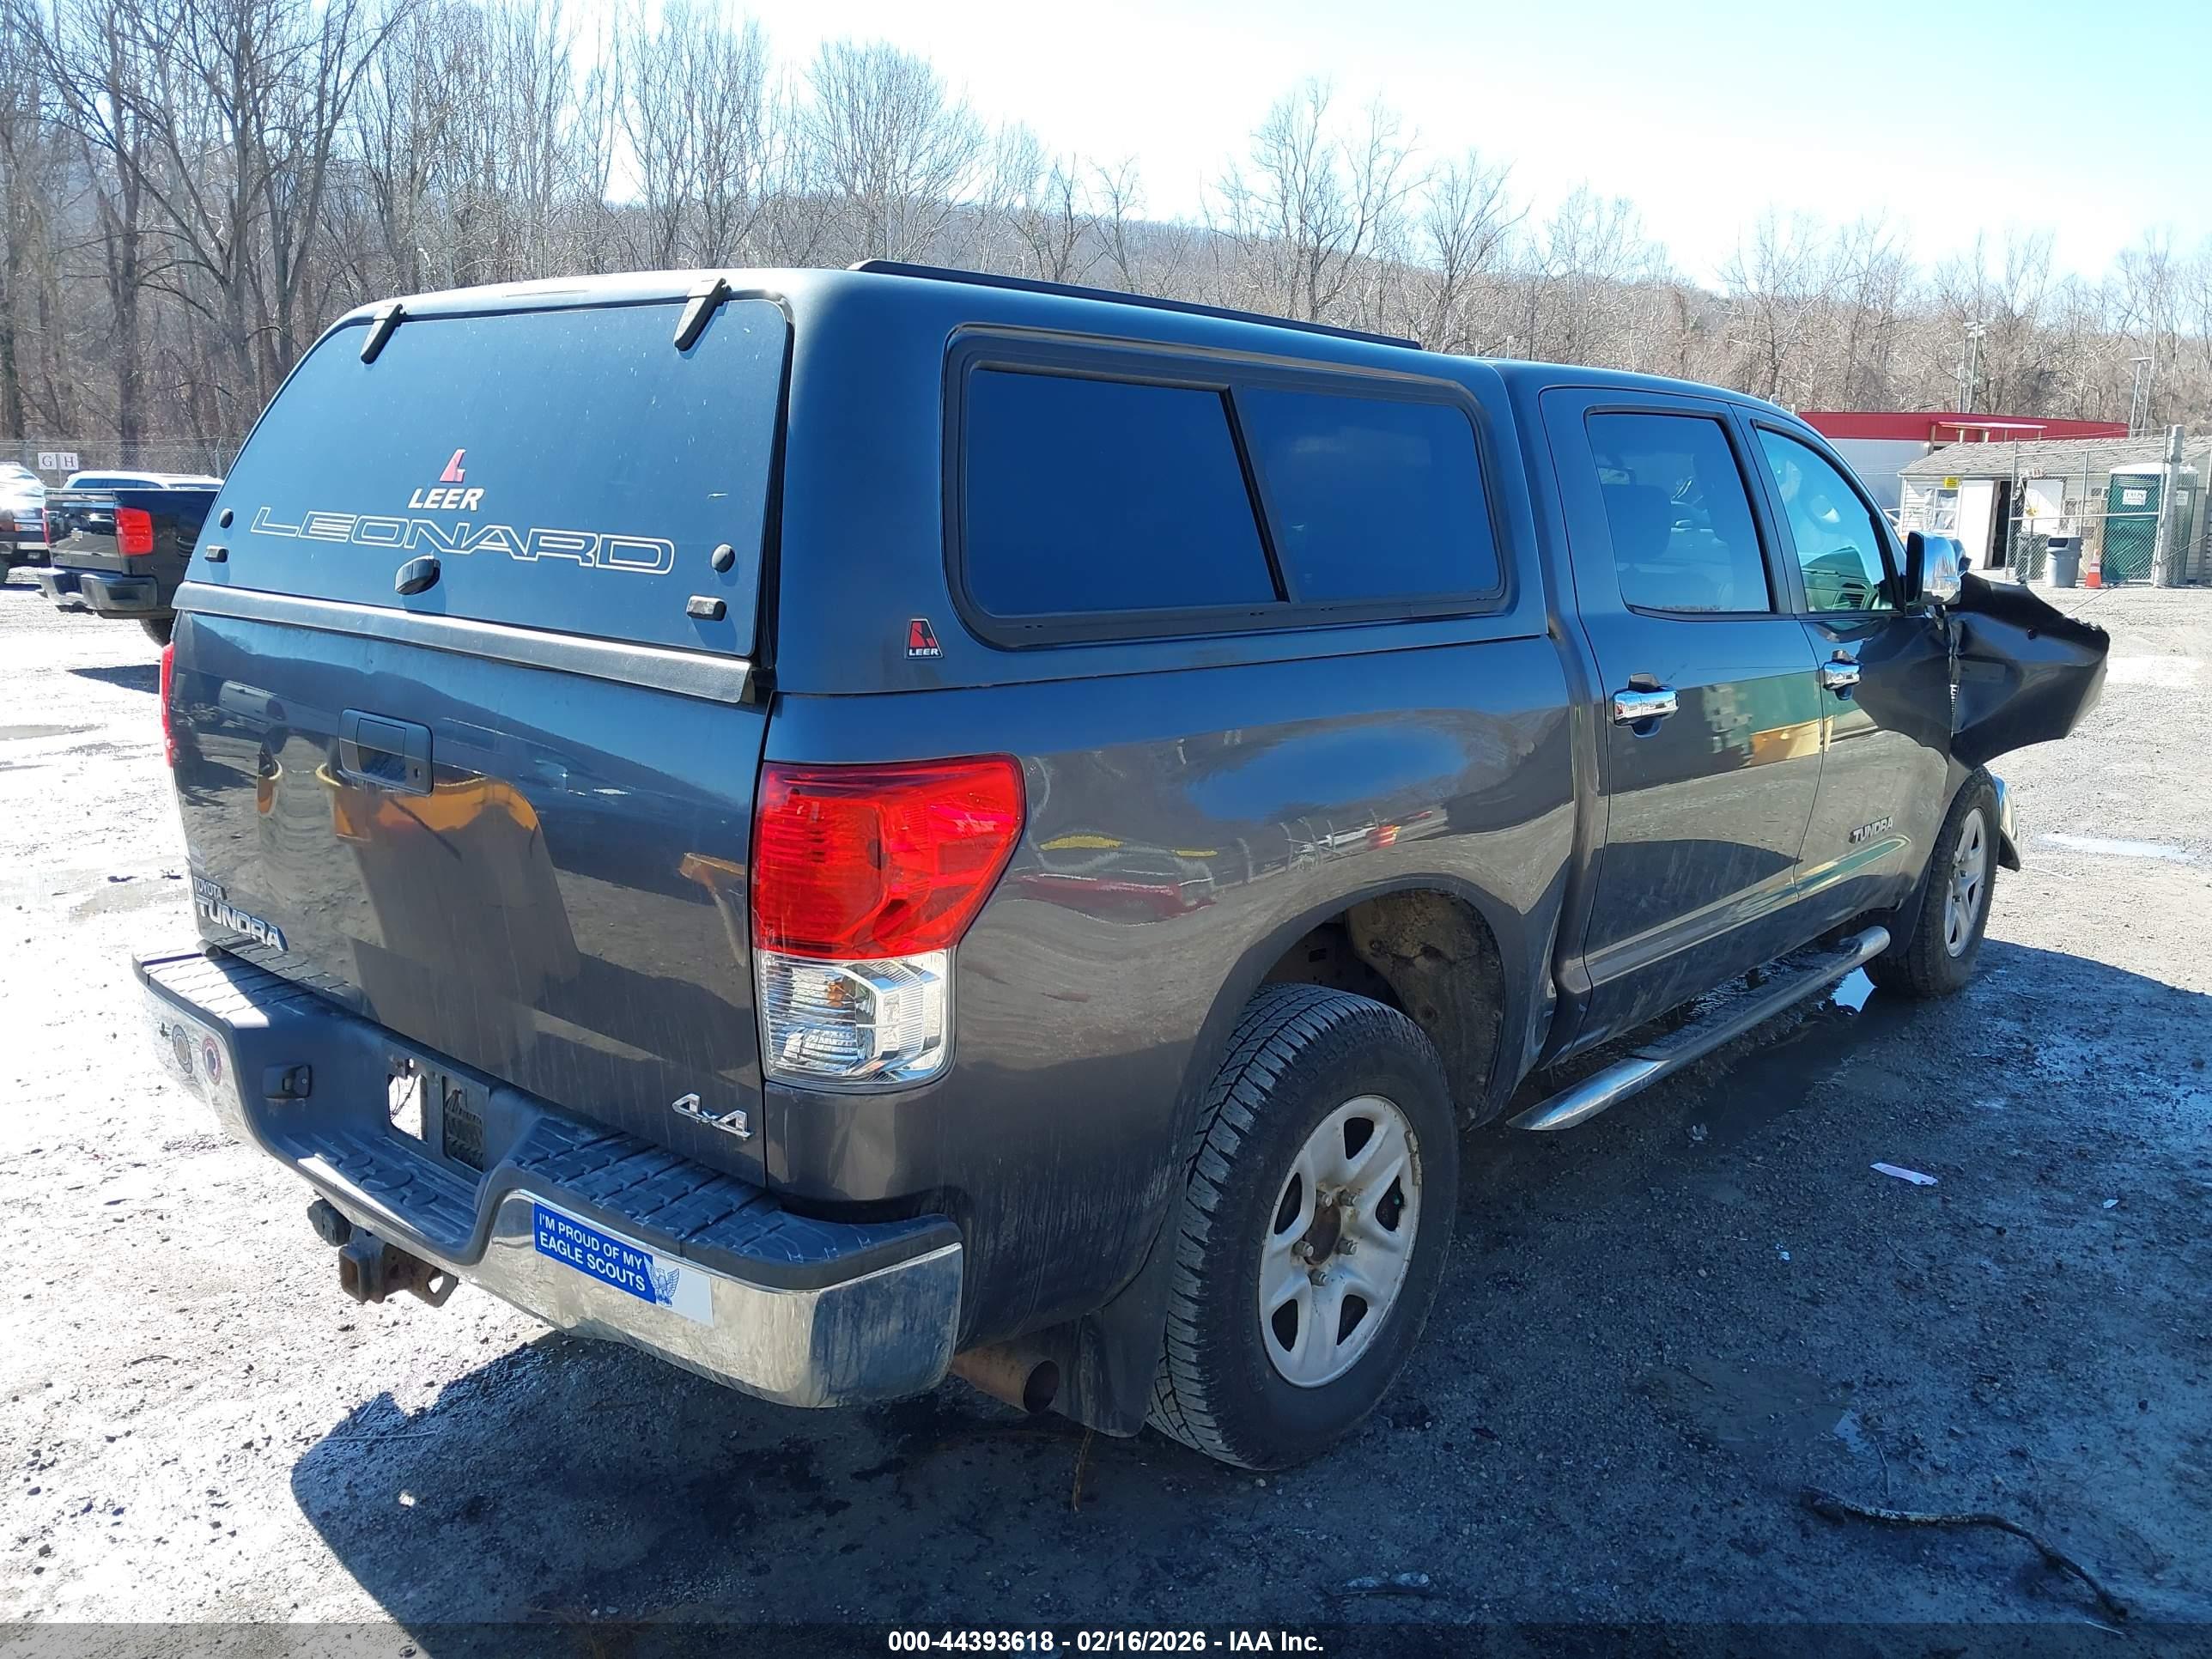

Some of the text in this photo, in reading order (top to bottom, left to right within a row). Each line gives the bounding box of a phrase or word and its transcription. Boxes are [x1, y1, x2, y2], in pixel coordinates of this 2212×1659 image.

[42, 456, 52, 467] G
[64, 457, 74, 467] H
[408, 487, 485, 512] LEER
[250, 507, 675, 574] LEONARD
[908, 647, 939, 656] LEER
[1852, 817, 1893, 842] TUNDRA
[193, 876, 224, 901] TOYOTA
[195, 893, 287, 952] TUNDRA
[538, 1212, 643, 1271] I'M PROUD OF MY
[539, 1231, 646, 1292] EAGLE SCOUTS
